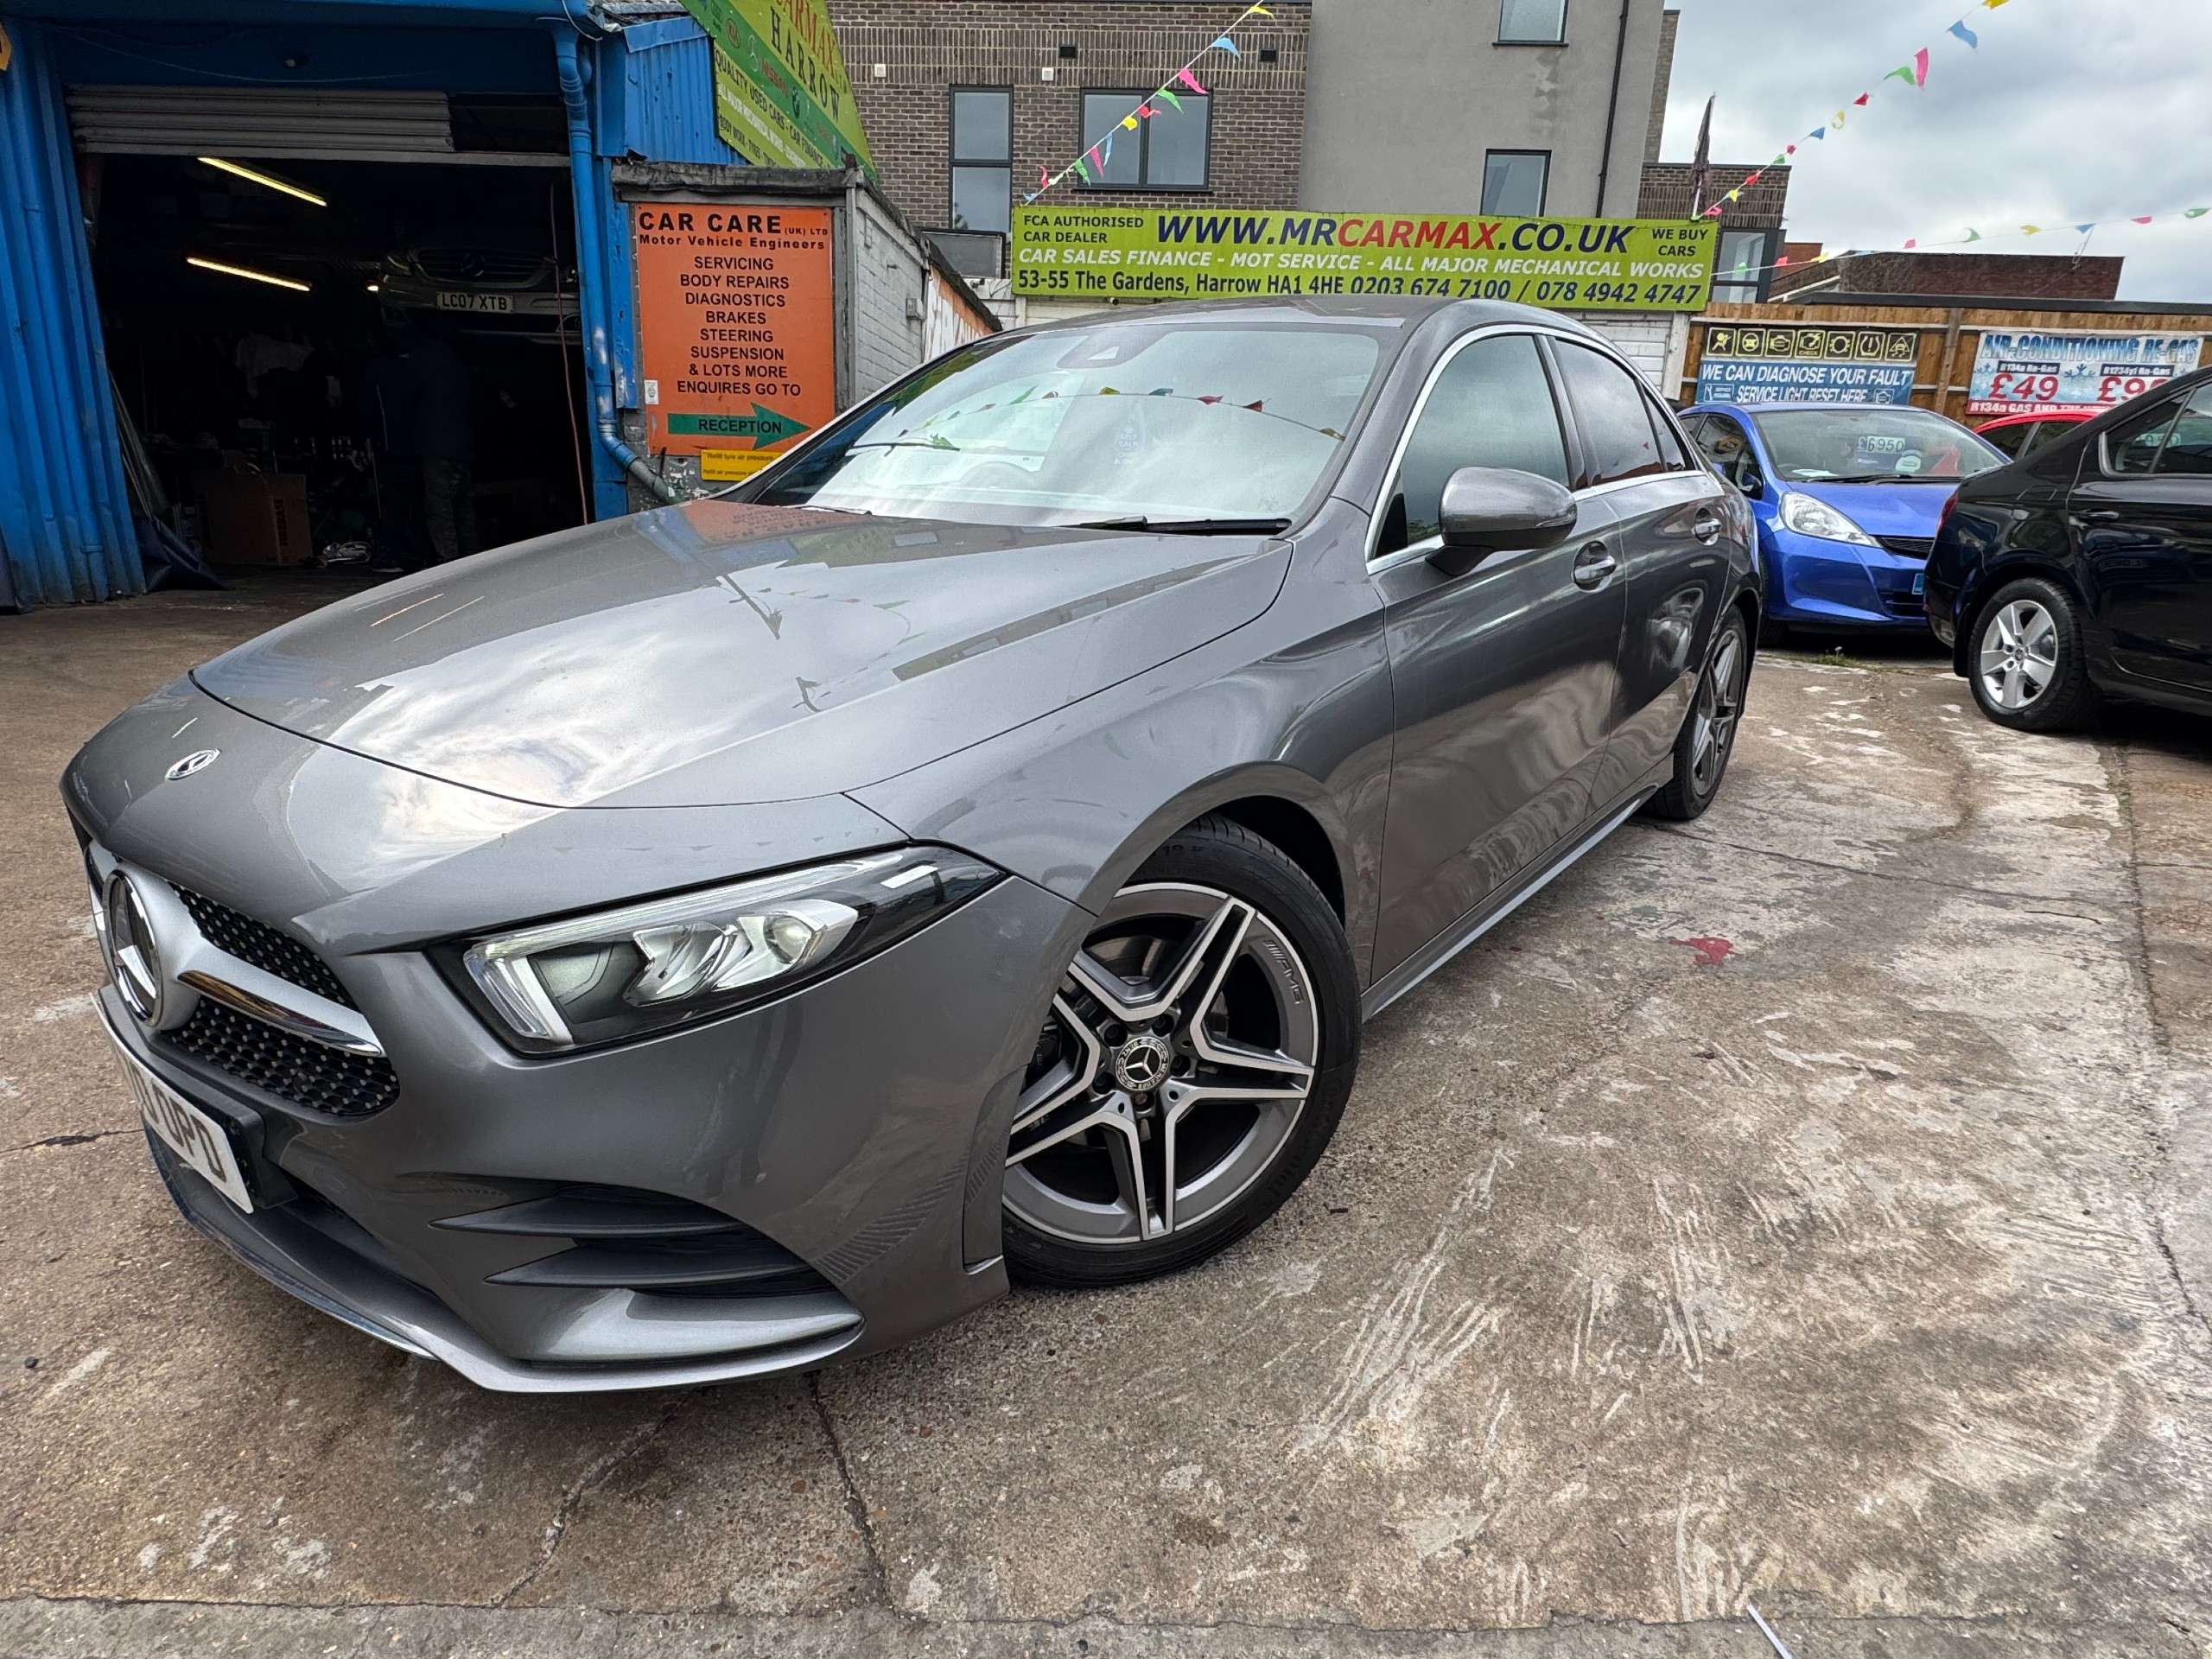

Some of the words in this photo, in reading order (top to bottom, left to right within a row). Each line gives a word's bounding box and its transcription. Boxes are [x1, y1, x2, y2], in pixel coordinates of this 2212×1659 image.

[777, 0, 836, 79] ARMAX
[771, 6, 839, 122] HARROW
[714, 48, 749, 93] QUALITY
[749, 84, 768, 112] USED
[768, 103, 785, 130] CARS
[789, 124, 801, 146] CAR
[639, 212, 694, 232] CAR
[708, 213, 781, 234] CARE
[785, 227, 806, 236] (UK)
[810, 227, 829, 236] LTD
[1024, 215, 1049, 226] FCA
[1053, 215, 1144, 228] AUTHORISED
[1024, 232, 1051, 243] CAR
[1055, 232, 1108, 244] DEALER
[1158, 214, 1634, 253] WWW.MRCARMAX.CO.UK
[1652, 228, 1674, 240] WE
[1679, 228, 1708, 240] BUY
[639, 234, 682, 245] Motor
[688, 235, 743, 247] Vehicle
[750, 237, 824, 251] Engineers
[1658, 245, 1695, 257] CARS
[694, 256, 774, 270] SERVICING
[1019, 248, 1058, 264] CAR
[1063, 249, 1121, 264] SALES
[1127, 251, 1211, 267] FINANCE
[1230, 252, 1274, 268] MOT
[1277, 253, 1362, 270] SERVICE
[1379, 255, 1414, 271] ALL
[1421, 257, 1489, 273] MAJOR
[1494, 258, 1621, 276] MECHANICAL
[1630, 261, 1704, 278] WORKS
[680, 274, 721, 288] BODY
[726, 275, 789, 289] REPAIRS
[1018, 270, 1069, 289] 53-55
[1075, 270, 1106, 290] The
[1112, 270, 1190, 296] Gardens,
[1197, 273, 1262, 293] Harrow
[1267, 275, 1302, 295] HA1
[1309, 276, 1344, 295] 4HE
[1351, 276, 1404, 295] 0203
[1411, 277, 1451, 296] 674
[1457, 278, 1510, 300] 7100
[1516, 280, 1531, 303] /
[1536, 280, 1579, 302] 078
[1583, 282, 1638, 303] 4942
[1643, 283, 1701, 304] 4747
[442, 294, 474, 308] LC07
[479, 295, 507, 310] XTB
[685, 292, 785, 308] DIAGNOSTICS
[706, 310, 766, 325] BRAKES
[700, 328, 773, 342] STEERING
[690, 346, 785, 360] SUSPENSION
[1980, 334, 2139, 362] AIR-CONDITIONING
[2142, 338, 2199, 363] RE-GAS
[690, 364, 699, 376] &
[703, 364, 741, 377] LOTS
[745, 365, 788, 378] MORE
[1702, 364, 1721, 381] WE
[1726, 365, 1754, 383] CAN
[1757, 366, 1827, 384] DIAGNOSE
[1829, 367, 1866, 385] YOUR
[1867, 369, 1911, 386] FAULT
[677, 380, 751, 395] ENQUIRES
[755, 383, 778, 396] GO
[781, 384, 801, 397] TO
[1736, 385, 1778, 403] SERVICE
[1777, 386, 1808, 403] LIGHT
[1809, 388, 1841, 402] RESET
[1988, 372, 2059, 401] £49
[1970, 402, 2006, 413] R134a
[2008, 403, 2032, 413] GAS
[698, 418, 782, 434] RECEPTION
